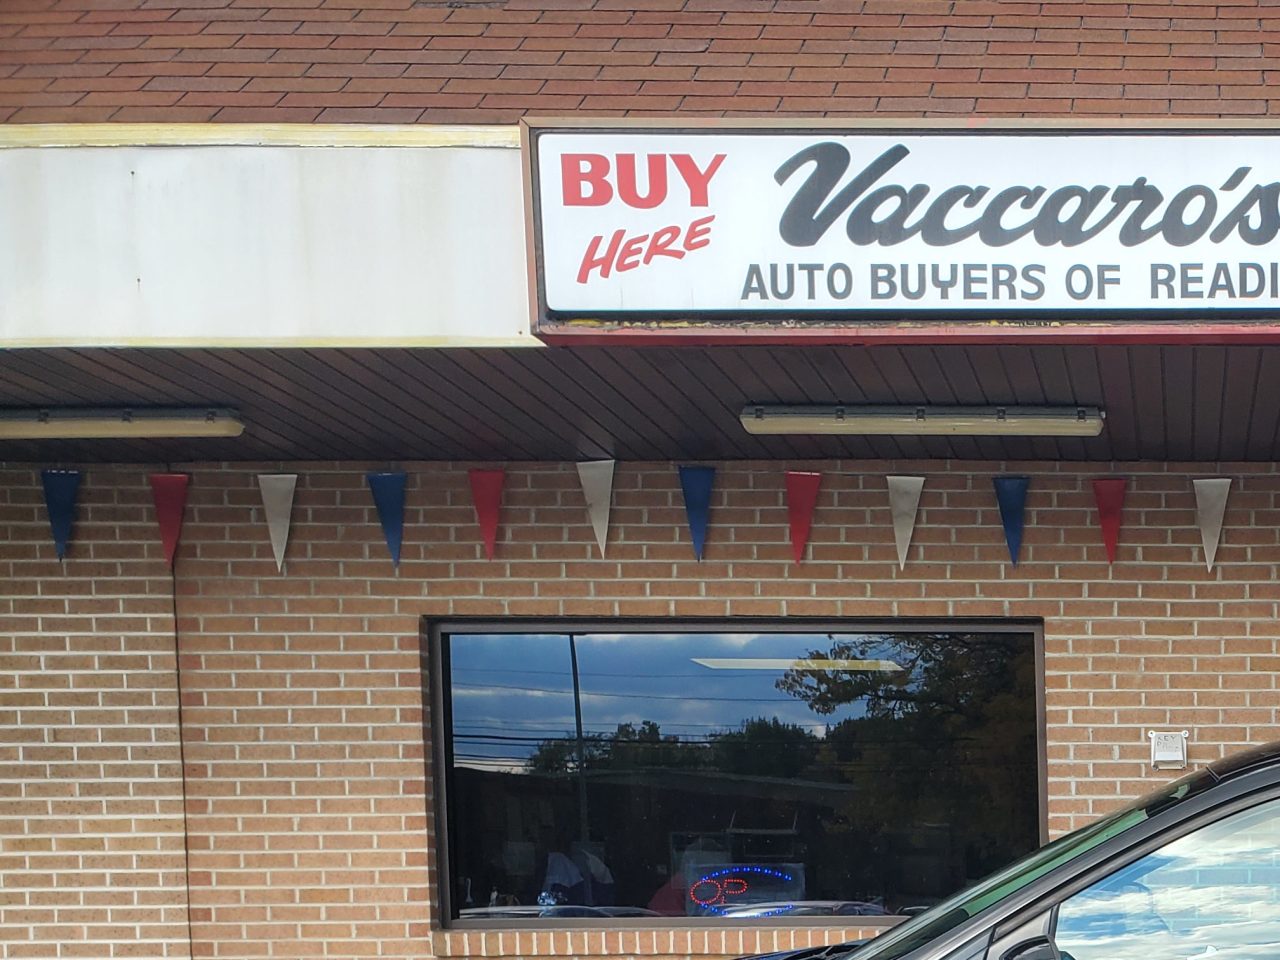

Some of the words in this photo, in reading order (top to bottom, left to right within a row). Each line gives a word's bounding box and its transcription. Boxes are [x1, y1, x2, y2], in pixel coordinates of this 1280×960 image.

[560, 153, 728, 208] BUY
[576, 215, 716, 284] HERE
[740, 263, 853, 301] AUTO
[870, 263, 1046, 301] BUYERS
[1064, 263, 1121, 300] OF
